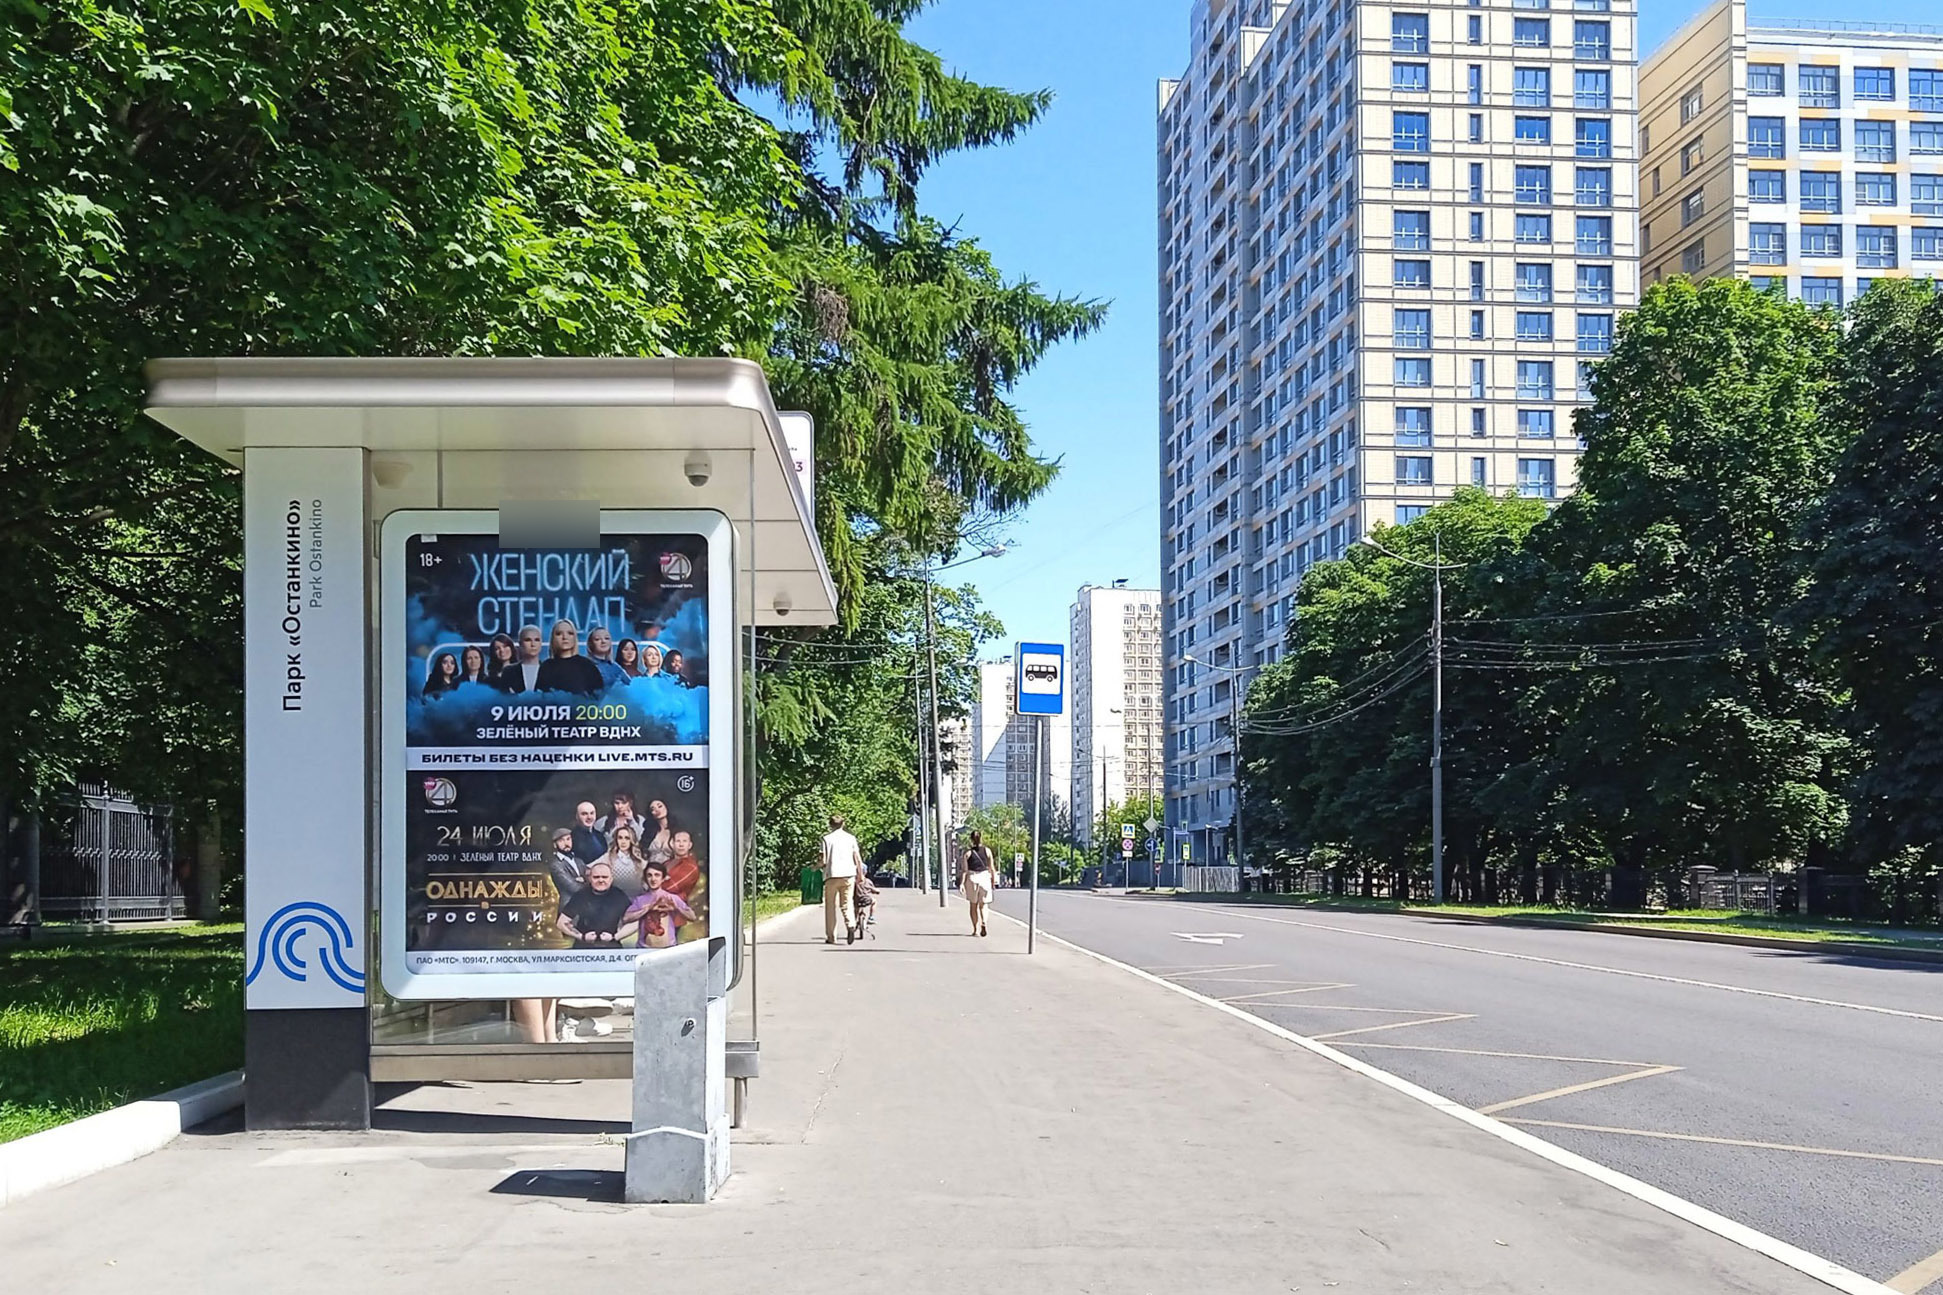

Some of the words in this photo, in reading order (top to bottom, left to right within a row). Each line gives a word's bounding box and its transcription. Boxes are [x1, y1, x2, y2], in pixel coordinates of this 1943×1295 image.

[308, 499, 322, 572] Ostankino
[420, 553, 443, 567] 18+
[281, 499, 302, 647] «Останкино»
[470, 549, 630, 591] ЖЕНСКИЙ
[309, 574, 322, 608] Park
[477, 596, 626, 635] СТЕНДАП
[282, 652, 306, 712] Парк
[490, 706, 504, 722] 9
[508, 705, 571, 721] ИЮЛЯ
[575, 704, 627, 720] 20:00
[476, 725, 549, 739] ЗЕЛЁНЫЙ
[552, 727, 597, 738] ТЕАТР
[600, 726, 642, 739] ВДНХ
[421, 753, 486, 763] БИЛЕТЫ
[488, 753, 518, 763] БЕЗ
[521, 753, 595, 764] НАЦЕНКИ
[598, 752, 694, 762] LIVE.MTS.RU
[437, 826, 462, 846] 24
[472, 825, 532, 846] ИЮЛЯ
[498, 851, 519, 862] ТЕАТР
[522, 851, 542, 862] ВДНХ
[426, 880, 543, 899] ОДНАЖДЫ
[426, 911, 544, 923] РОССИИ
[416, 956, 433, 965] ПАО
[463, 956, 489, 965] 109147,
